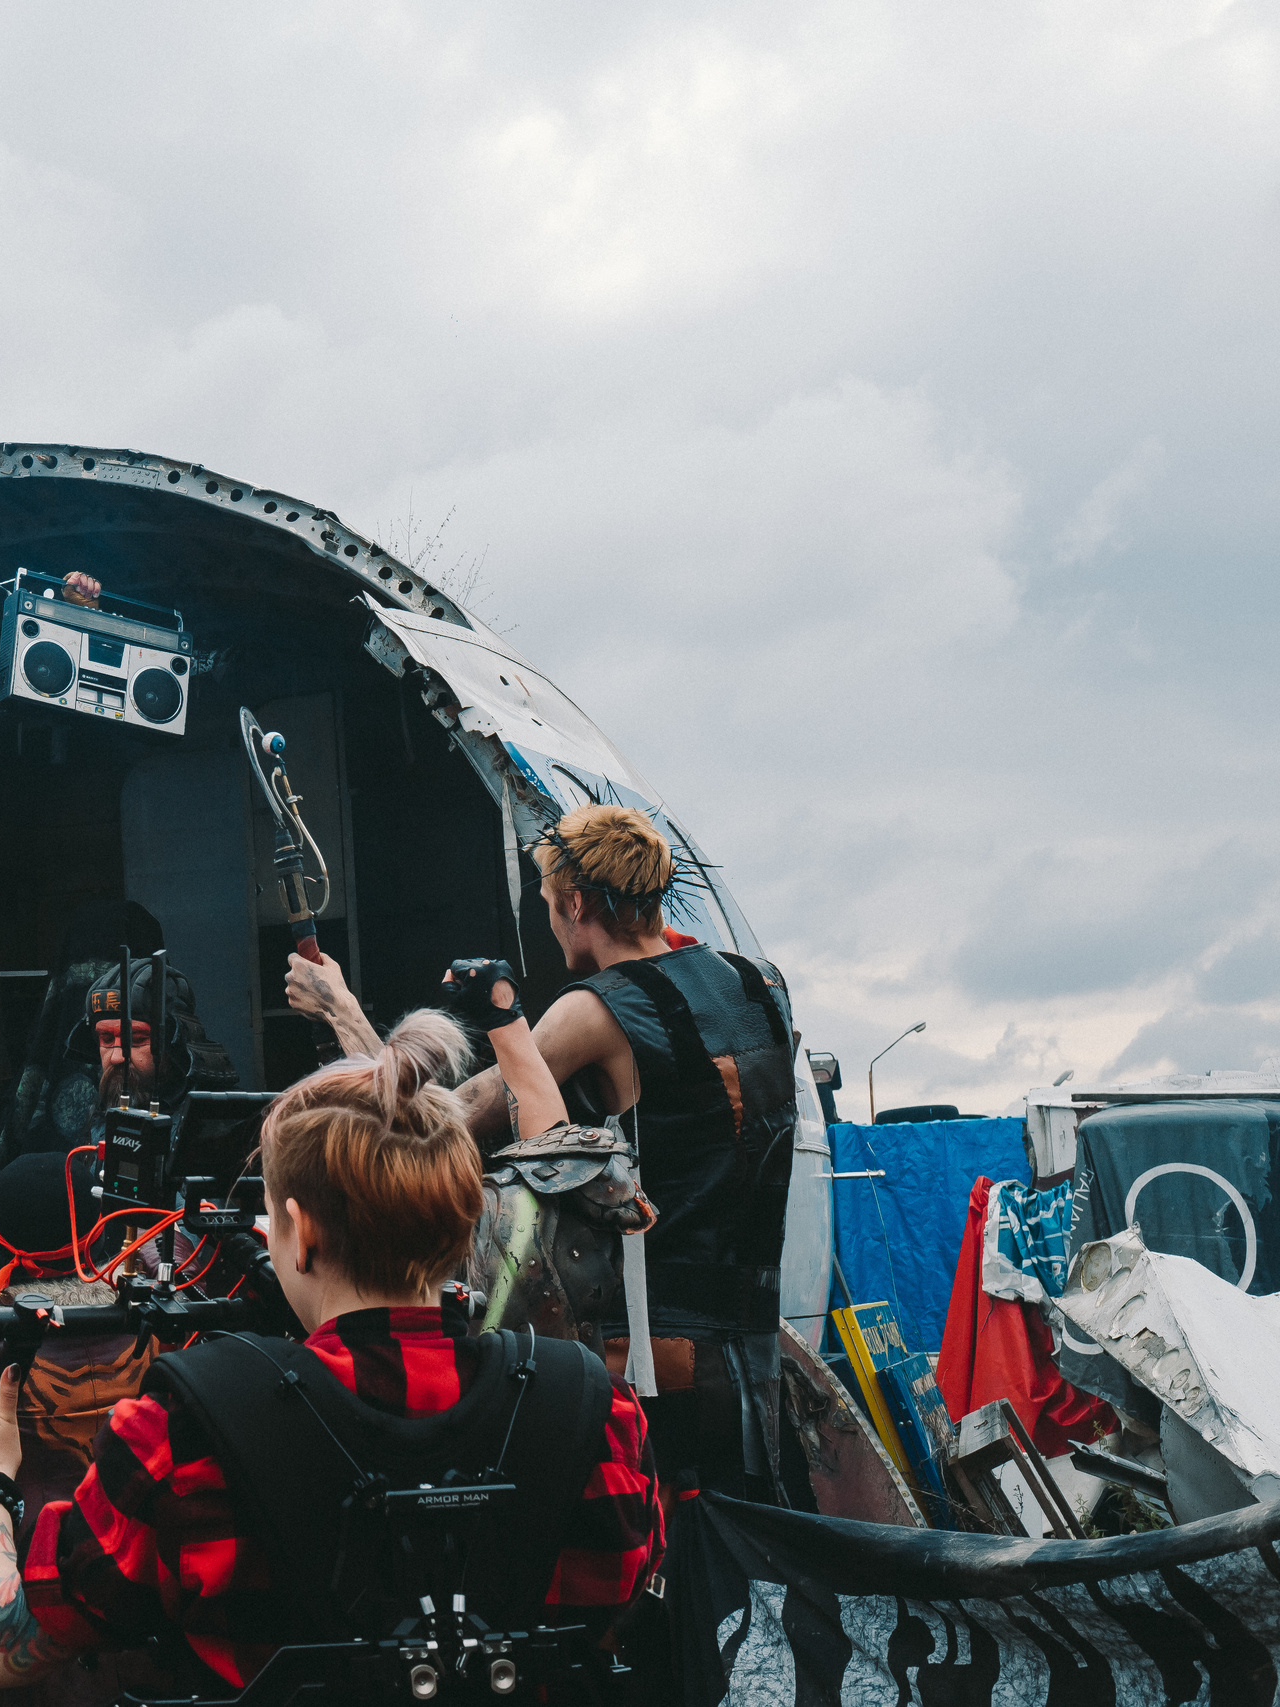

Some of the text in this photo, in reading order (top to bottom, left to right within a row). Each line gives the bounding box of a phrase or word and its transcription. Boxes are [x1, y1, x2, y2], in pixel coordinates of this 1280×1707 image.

[112, 1135, 142, 1153] VAXIS
[417, 1493, 489, 1505] ARMOR MAN
